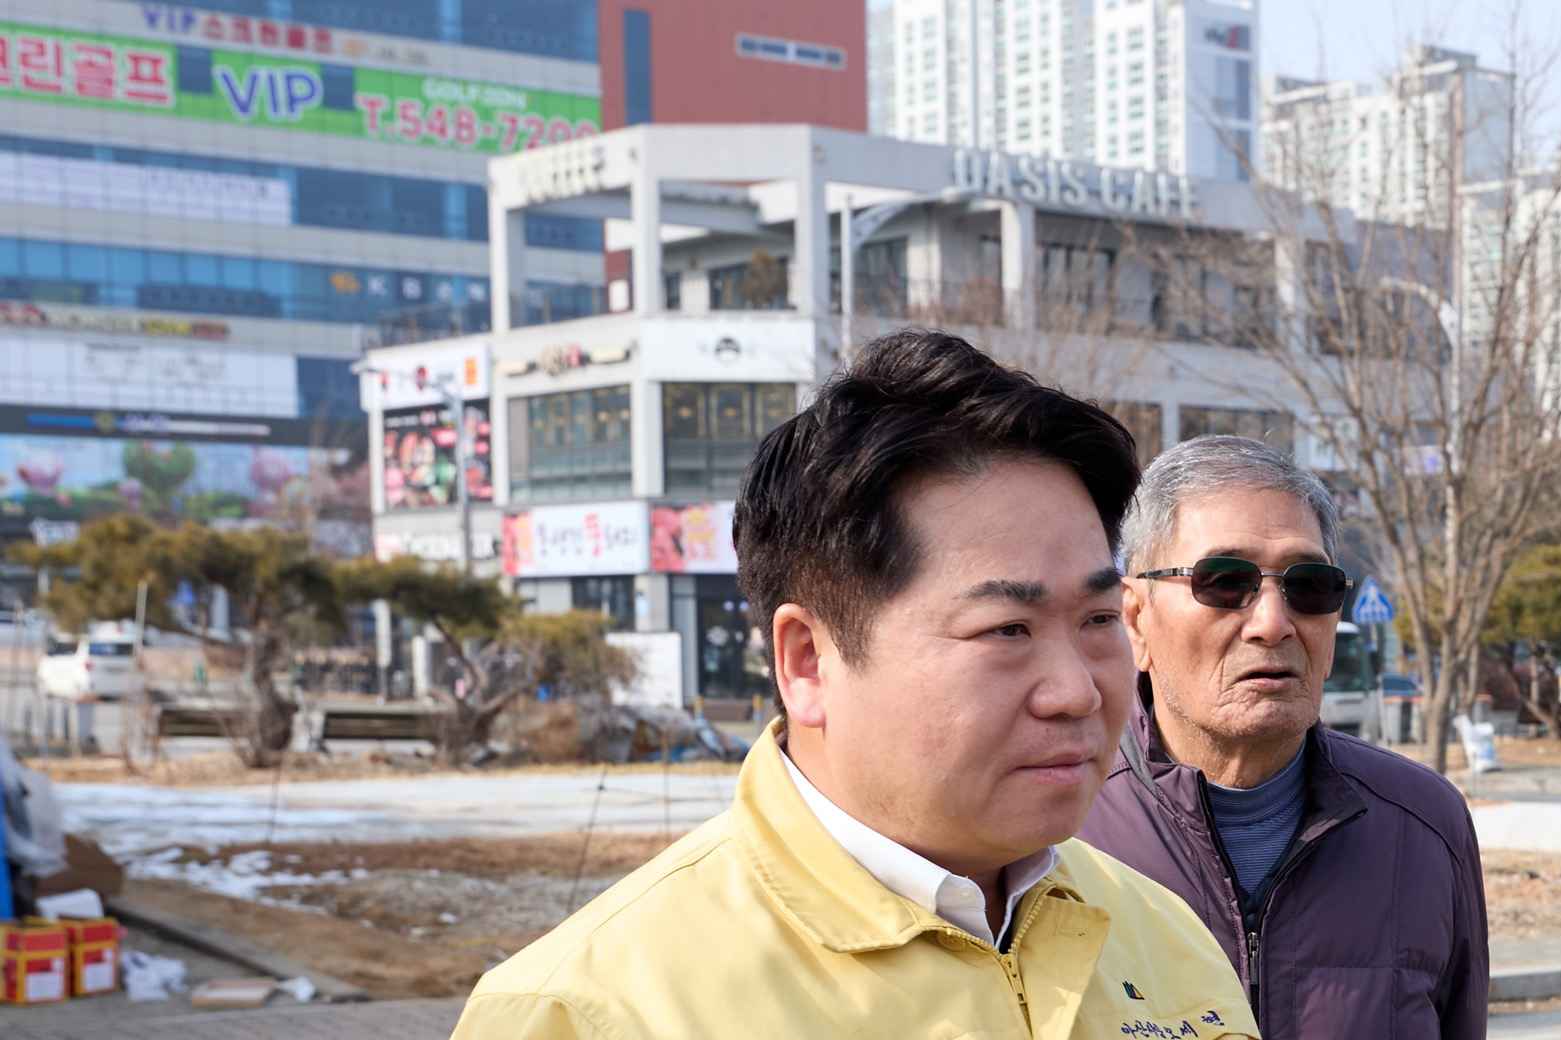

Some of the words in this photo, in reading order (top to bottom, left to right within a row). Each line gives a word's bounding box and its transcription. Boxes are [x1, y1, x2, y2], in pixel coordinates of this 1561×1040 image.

[144, 8, 196, 33] VIP
[0, 36, 171, 104] 린골프
[214, 66, 322, 118] VIP
